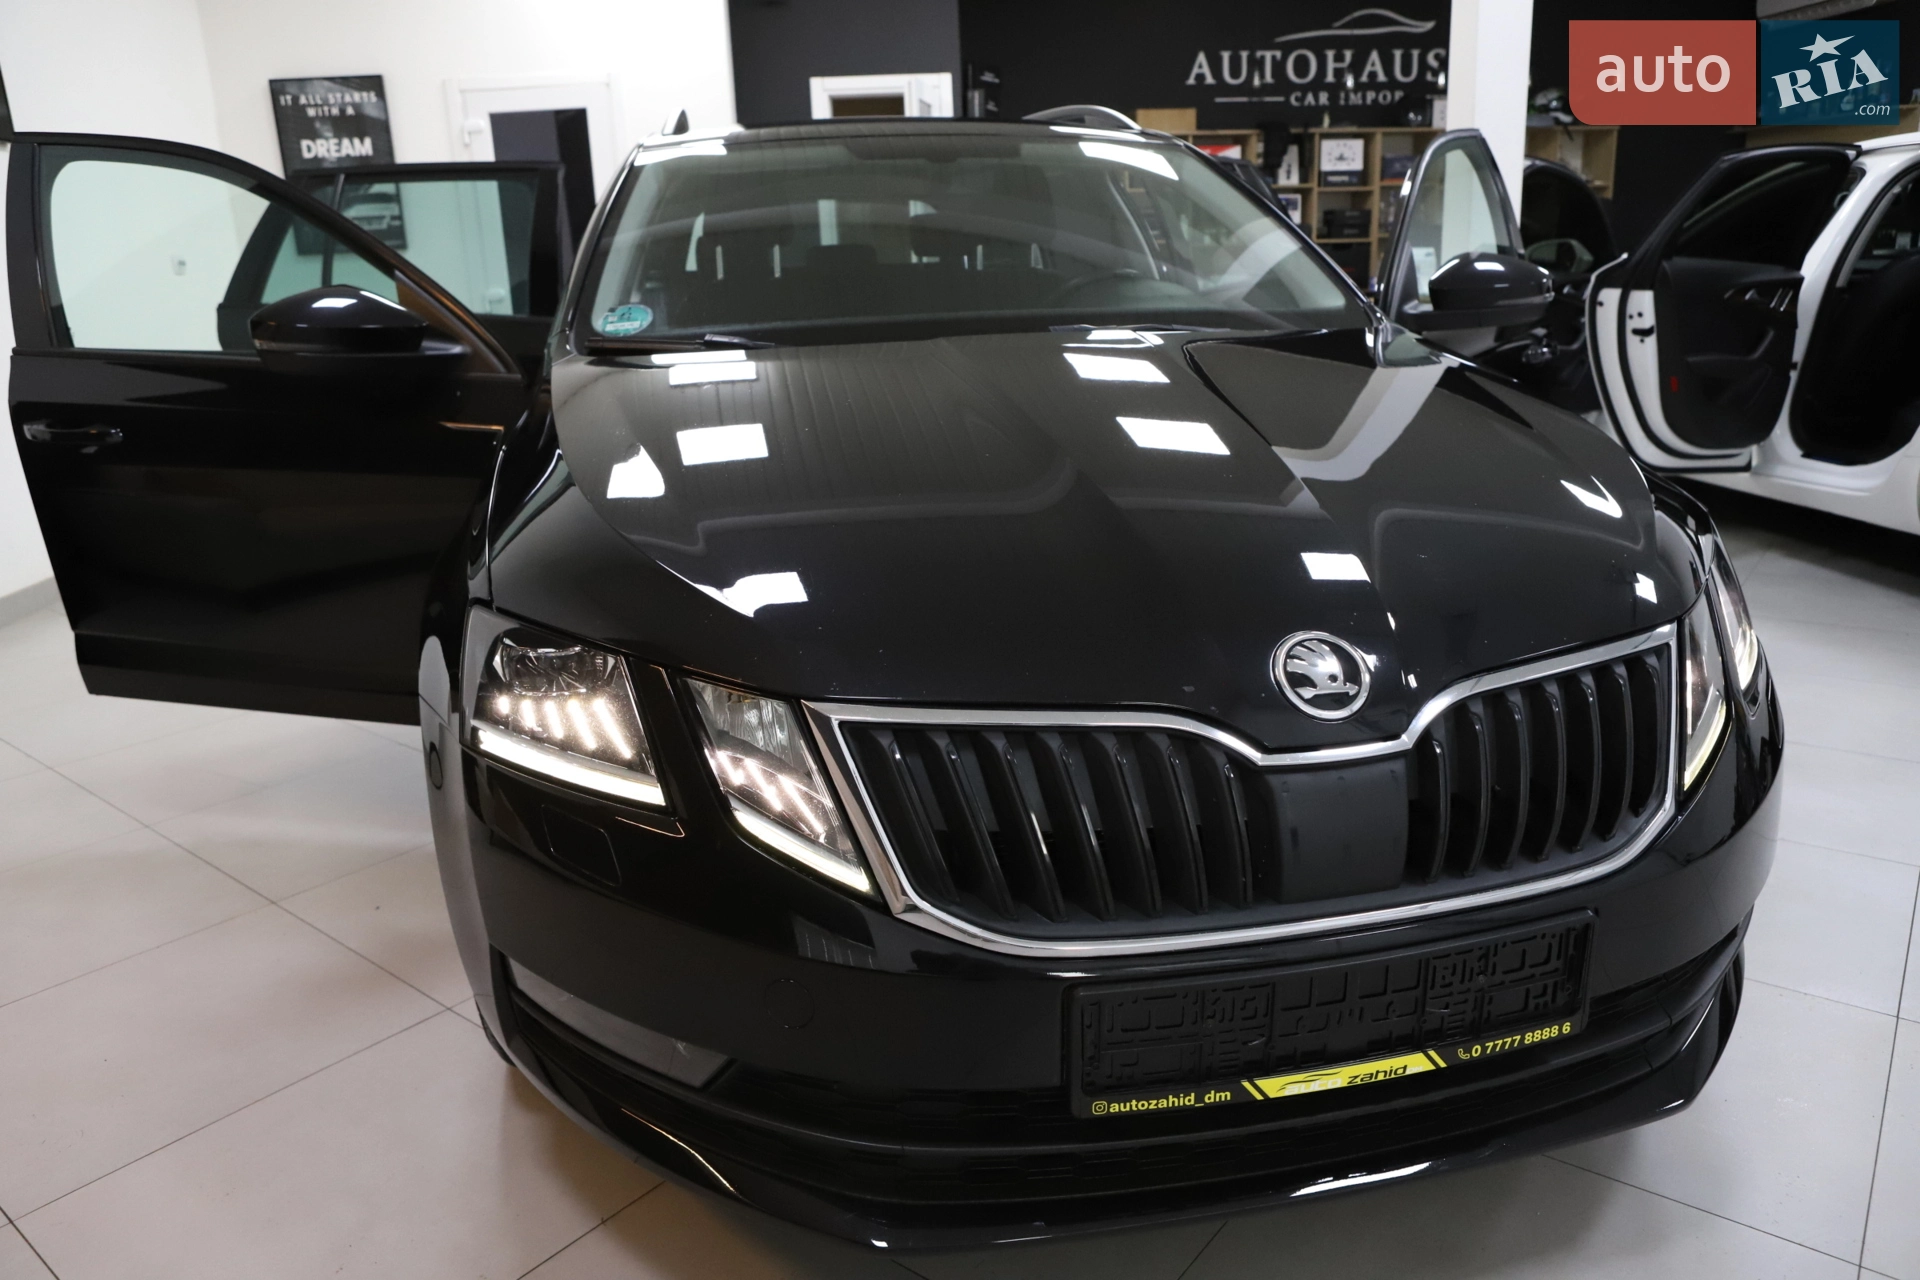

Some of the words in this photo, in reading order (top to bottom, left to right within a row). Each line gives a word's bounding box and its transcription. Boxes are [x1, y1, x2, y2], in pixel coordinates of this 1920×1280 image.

[1185, 48, 1448, 86] AUTOHAUS
[279, 94, 292, 106] IT
[299, 93, 323, 105] ALL
[328, 90, 377, 104] STARTS
[1289, 91, 1330, 107] CAR
[305, 105, 340, 117] WITH
[345, 104, 355, 116] A
[300, 136, 373, 159] DREAM
[1471, 1044, 1482, 1057] 0
[1485, 1035, 1521, 1054] 7777
[1524, 1025, 1559, 1044] 8888
[1562, 1022, 1571, 1034] 6
[1284, 1077, 1342, 1096] auto
[1347, 1065, 1408, 1085] zahid
[1109, 1090, 1231, 1113] autozahid_dm
